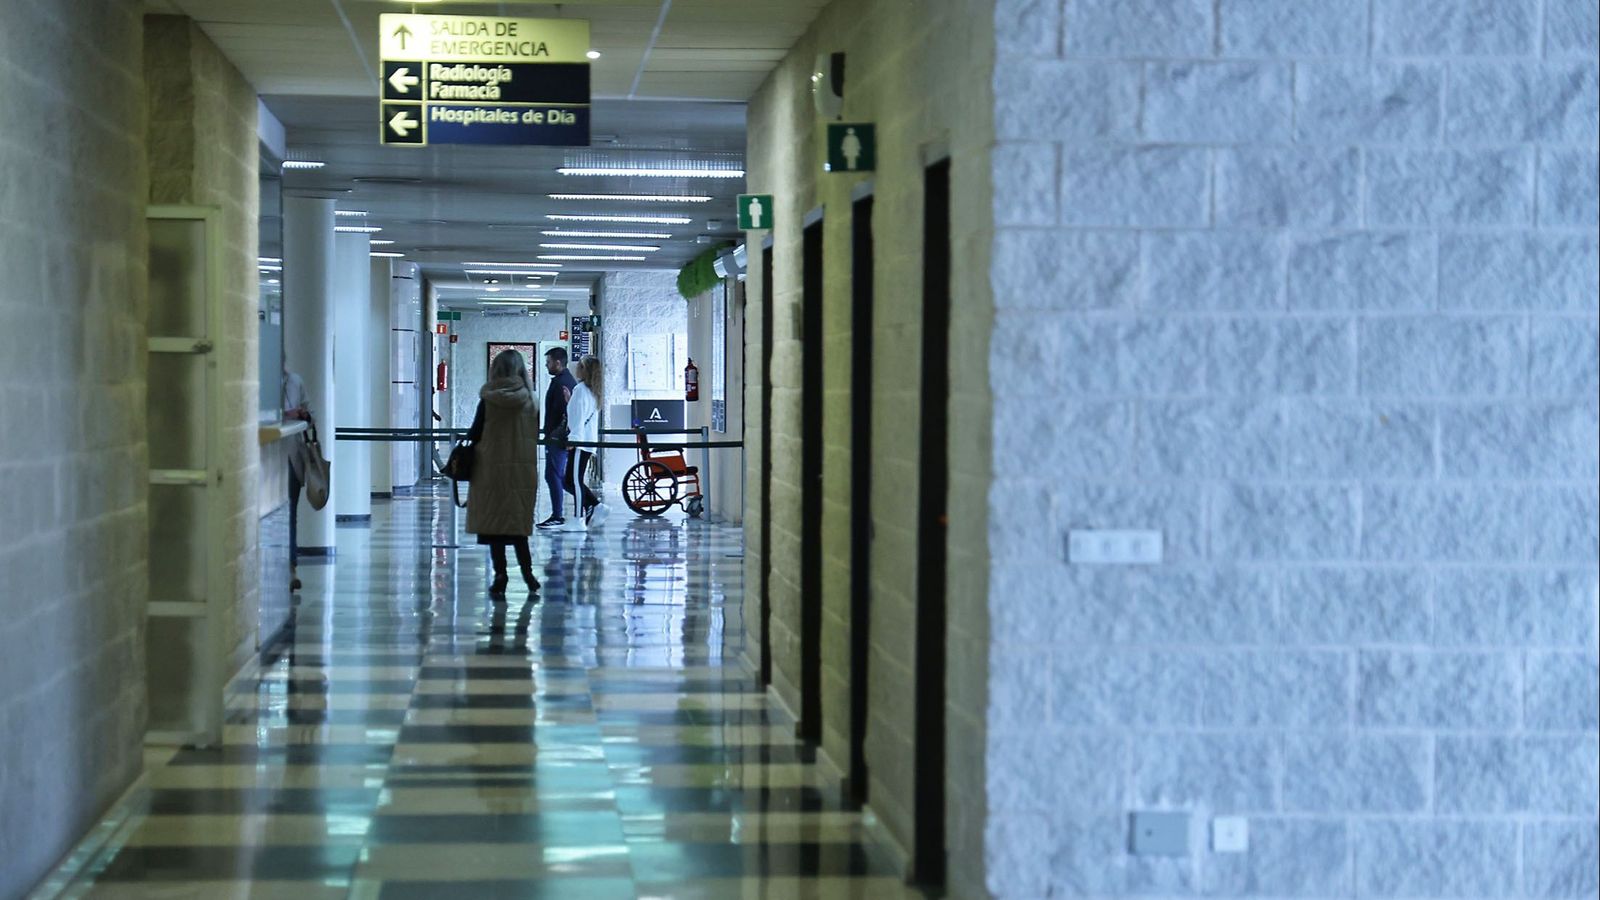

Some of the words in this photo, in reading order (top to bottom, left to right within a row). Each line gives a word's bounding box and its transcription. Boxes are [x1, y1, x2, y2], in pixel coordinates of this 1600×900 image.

[430, 21, 489, 37] SALIDA
[495, 22, 518, 37] DE
[430, 40, 549, 57] EMERGENCIA
[430, 63, 512, 86] Radiología
[431, 107, 518, 126] Hospitales
[522, 108, 543, 124] de
